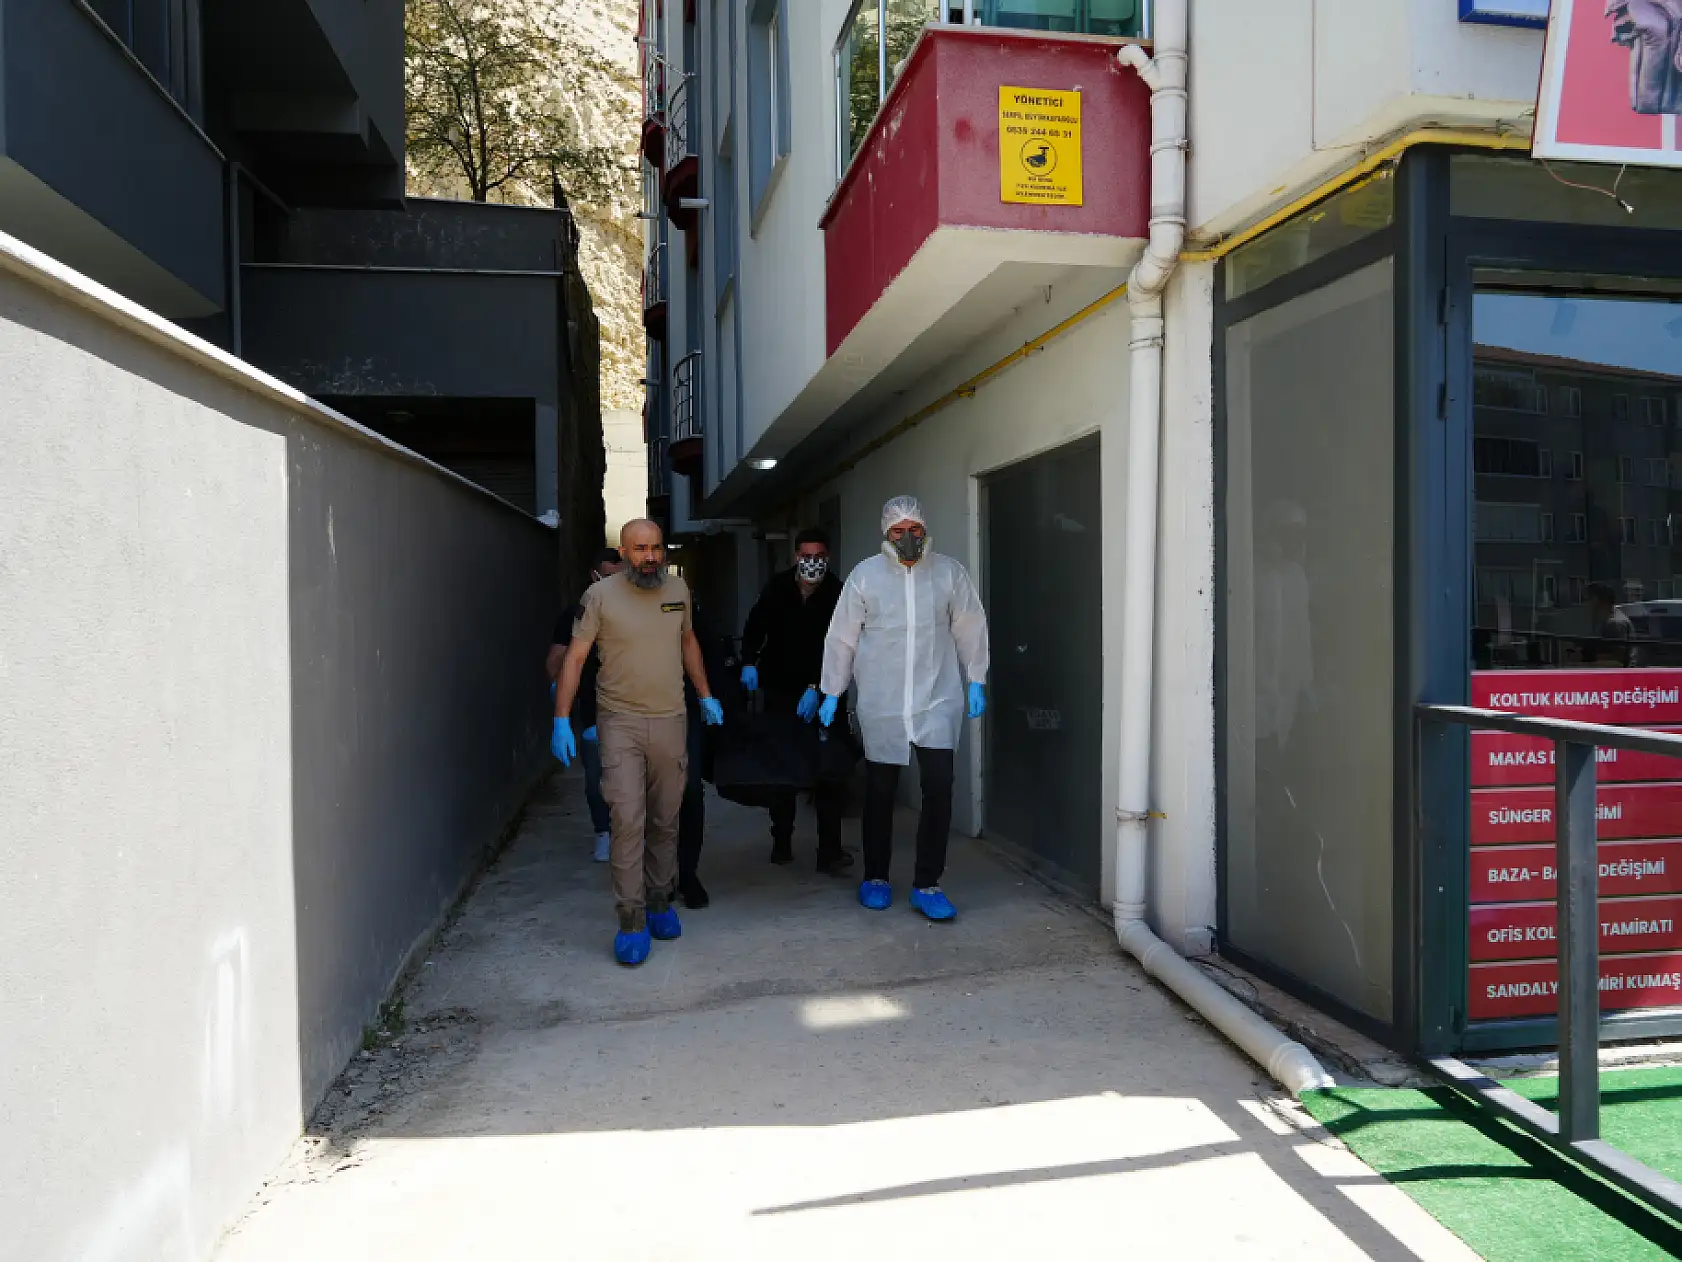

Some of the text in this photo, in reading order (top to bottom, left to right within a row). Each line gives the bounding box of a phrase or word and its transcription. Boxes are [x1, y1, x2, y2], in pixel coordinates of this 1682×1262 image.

[1014, 94, 1063, 108] YÖNETİCİ
[1490, 686, 1679, 709] KOLTUK KUMAŞ DEĞİŞİMİ
[1489, 750, 1547, 766] MAKAS
[1488, 807, 1552, 825] SÜNGER
[1488, 867, 1539, 884] BAZA-
[1598, 857, 1665, 880] DEĞİŞİMİ
[1487, 918, 1673, 943] OFİS KOL TAMİRATI
[1486, 981, 1558, 999] SANDALY
[1626, 972, 1681, 992] KUMAŞ
